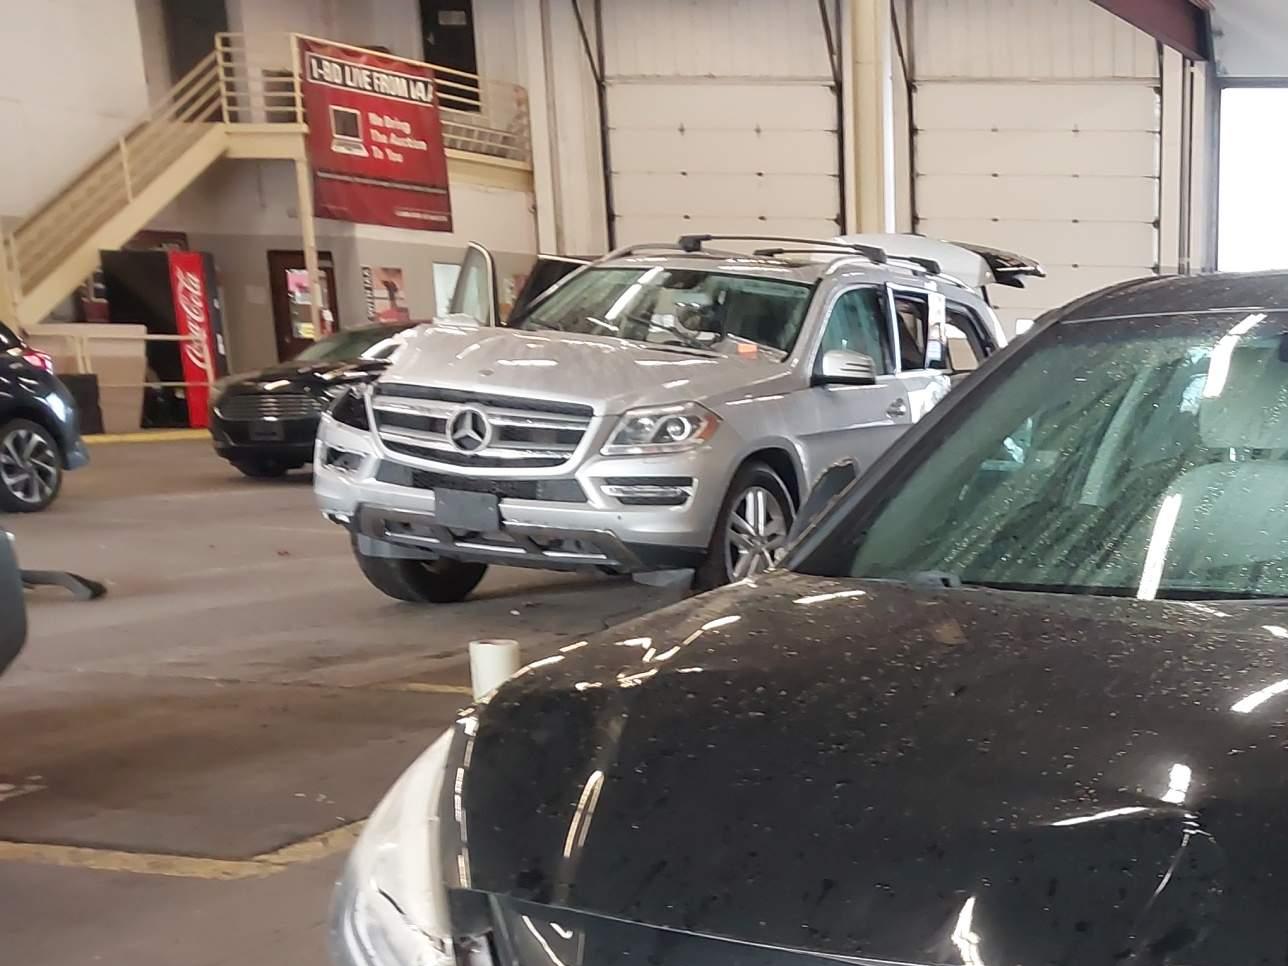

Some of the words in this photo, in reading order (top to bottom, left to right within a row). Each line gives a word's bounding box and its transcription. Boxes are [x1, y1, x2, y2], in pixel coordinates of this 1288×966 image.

[311, 58, 343, 84] I-BID
[344, 65, 373, 90] LIVE
[373, 72, 409, 98] FROM
